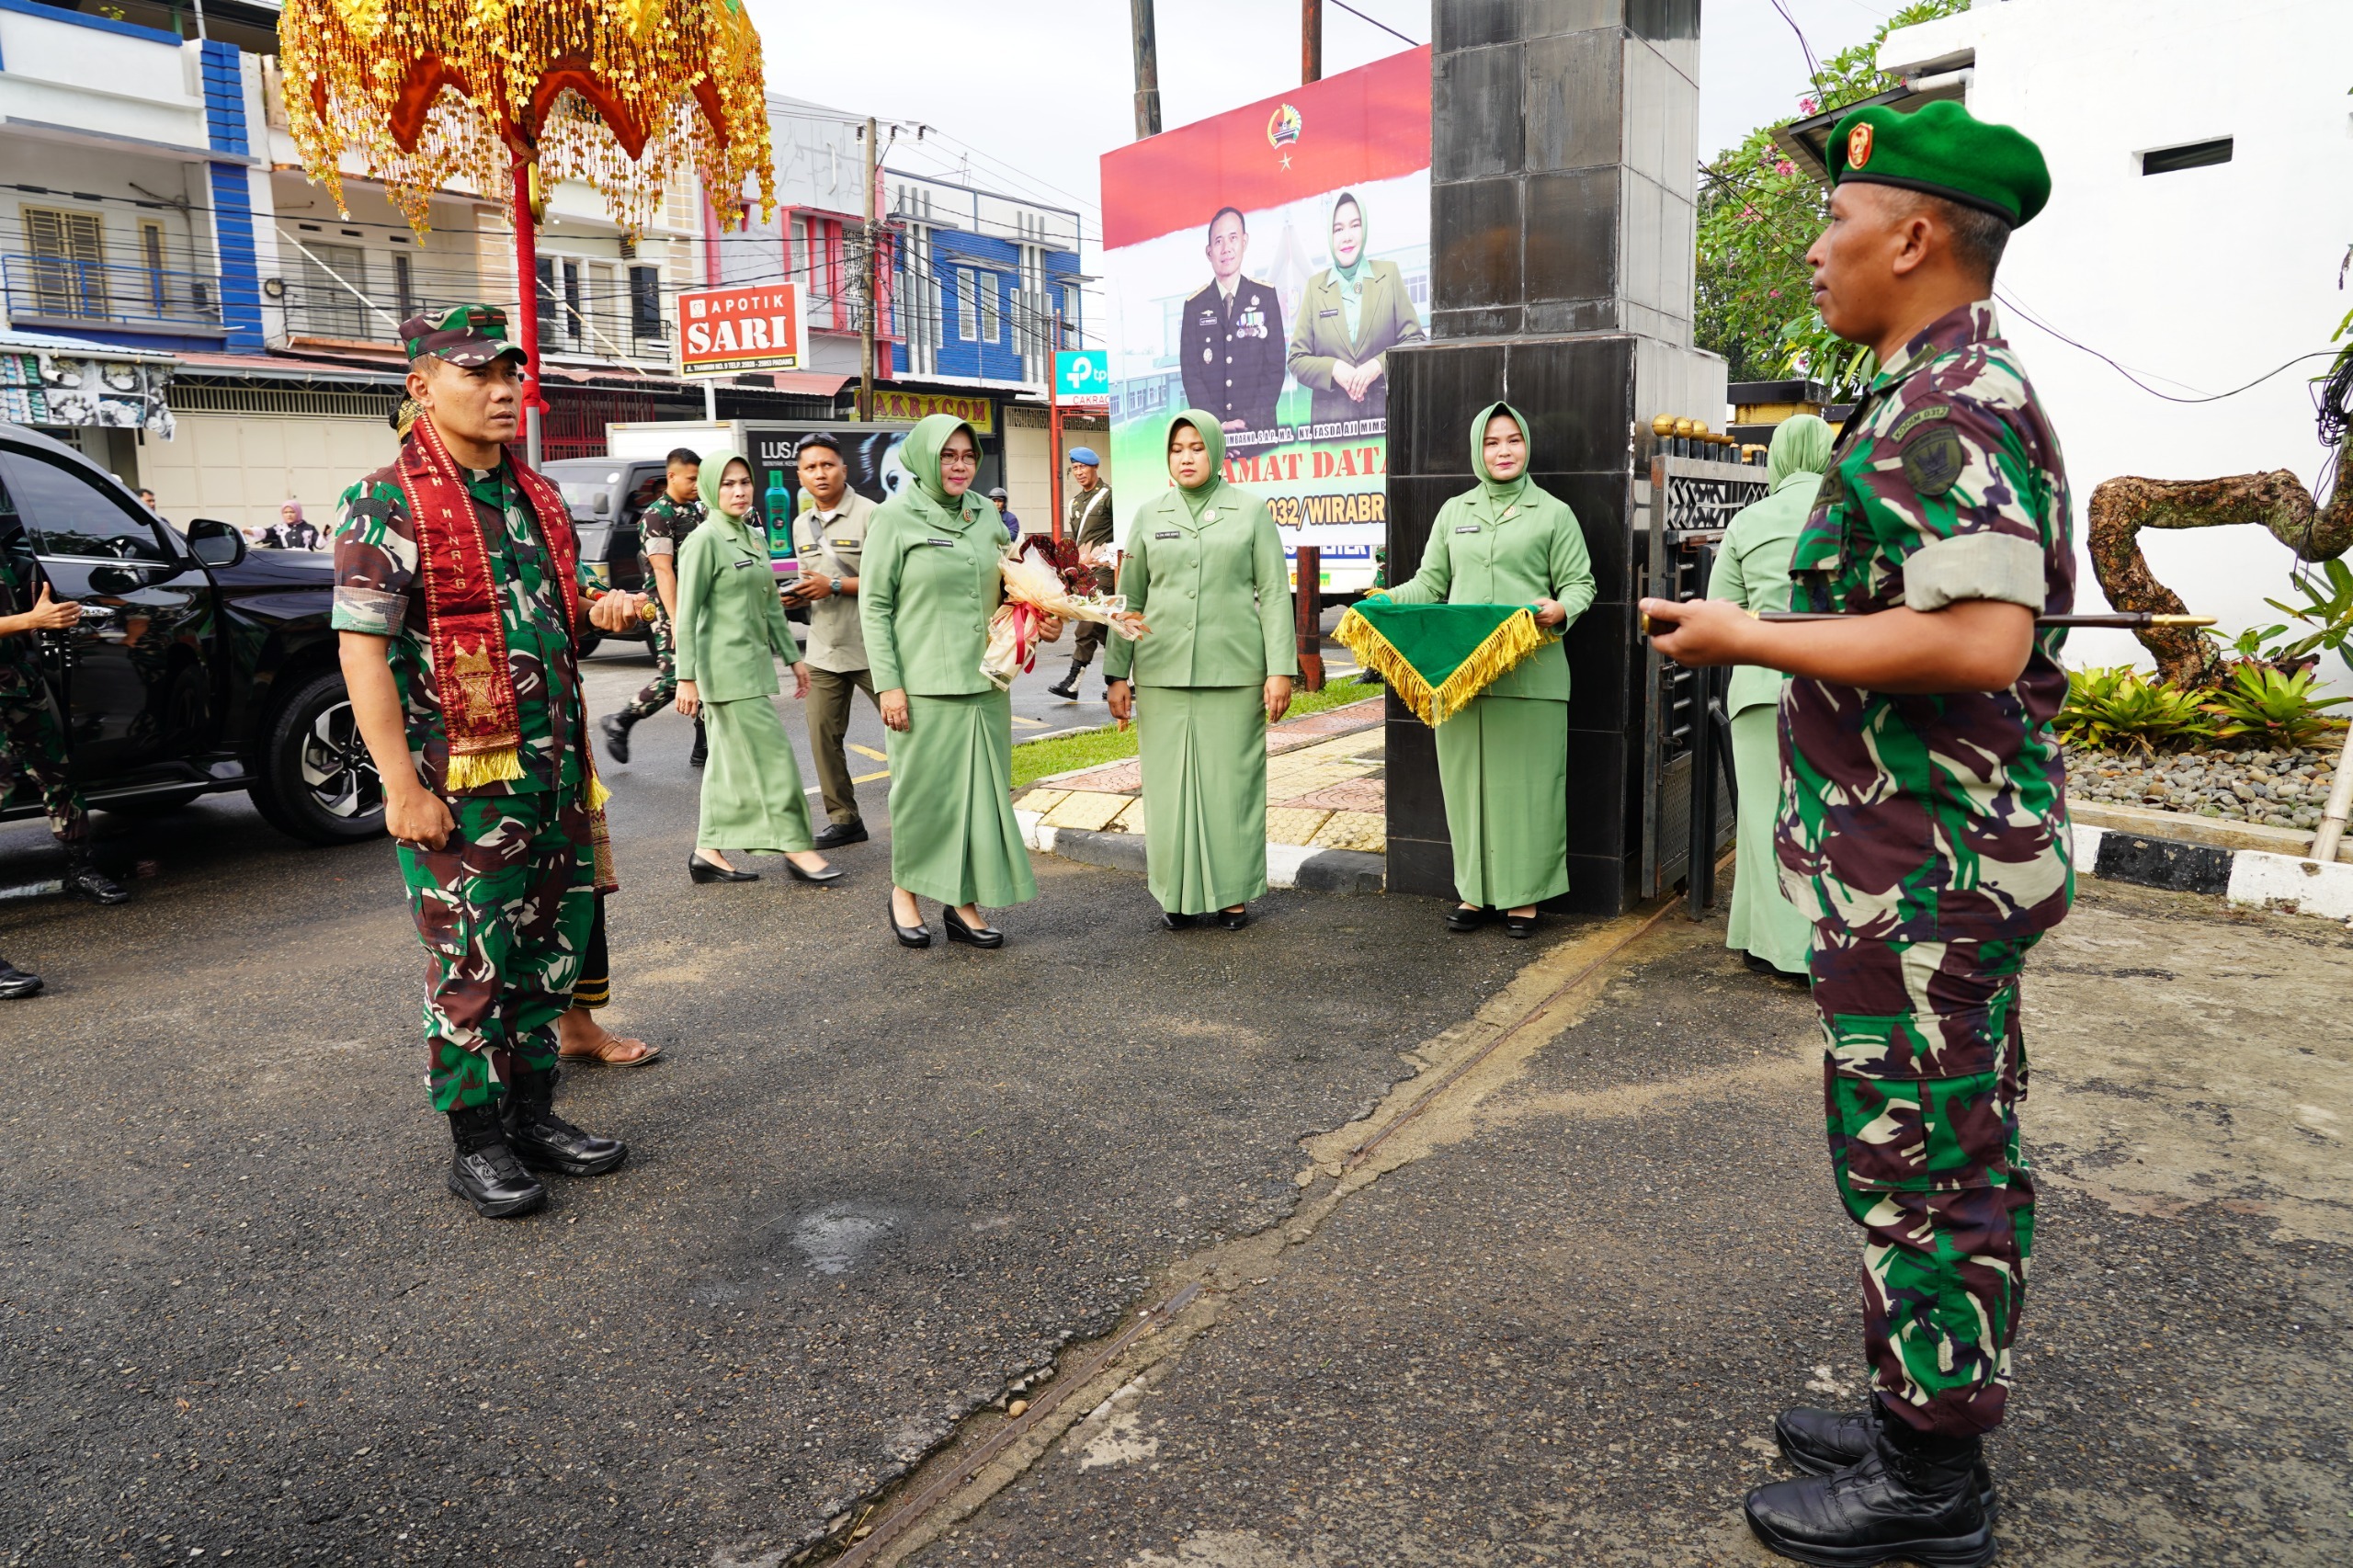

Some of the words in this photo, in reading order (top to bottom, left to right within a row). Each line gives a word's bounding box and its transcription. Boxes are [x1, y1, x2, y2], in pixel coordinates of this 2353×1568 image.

[711, 294, 784, 313] APOTIK
[688, 315, 788, 355] SARI
[772, 358, 794, 367] PADANG
[1225, 431, 1257, 446] IMBARNO.
[1313, 423, 1342, 439] FASDA
[1343, 421, 1358, 436] AJI
[1894, 414, 1921, 437] KODIM
[1220, 453, 1303, 484] AMAT
[442, 508, 466, 589] MINANG
